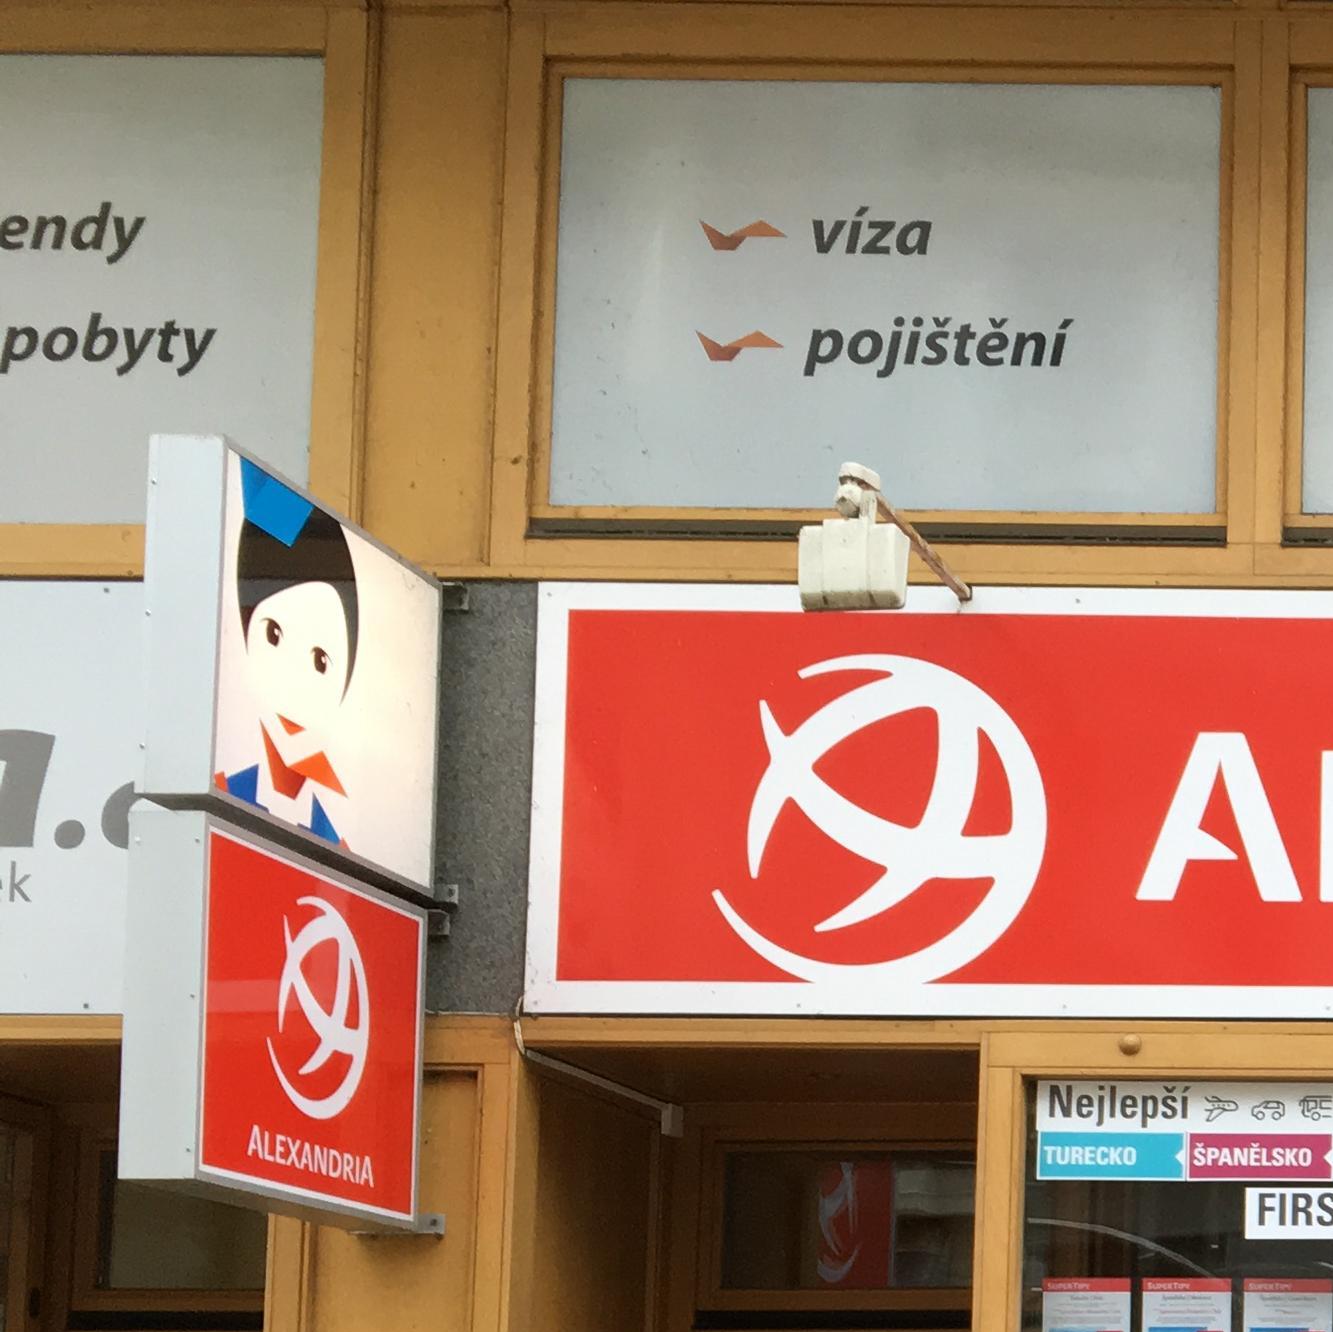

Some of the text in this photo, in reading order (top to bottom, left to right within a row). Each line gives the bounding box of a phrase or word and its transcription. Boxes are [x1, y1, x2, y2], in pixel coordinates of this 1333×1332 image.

[0, 201, 146, 265] endy
[813, 206, 932, 255] víza
[0, 311, 218, 378] pobyty
[804, 317, 1074, 378] pojištění
[1048, 1084, 1191, 1128] Nejlepší
[247, 1125, 373, 1188] ALEXANDRIA
[1044, 1146, 1136, 1165] TURECKO
[1193, 1143, 1312, 1166] ŠPANĚLSKO
